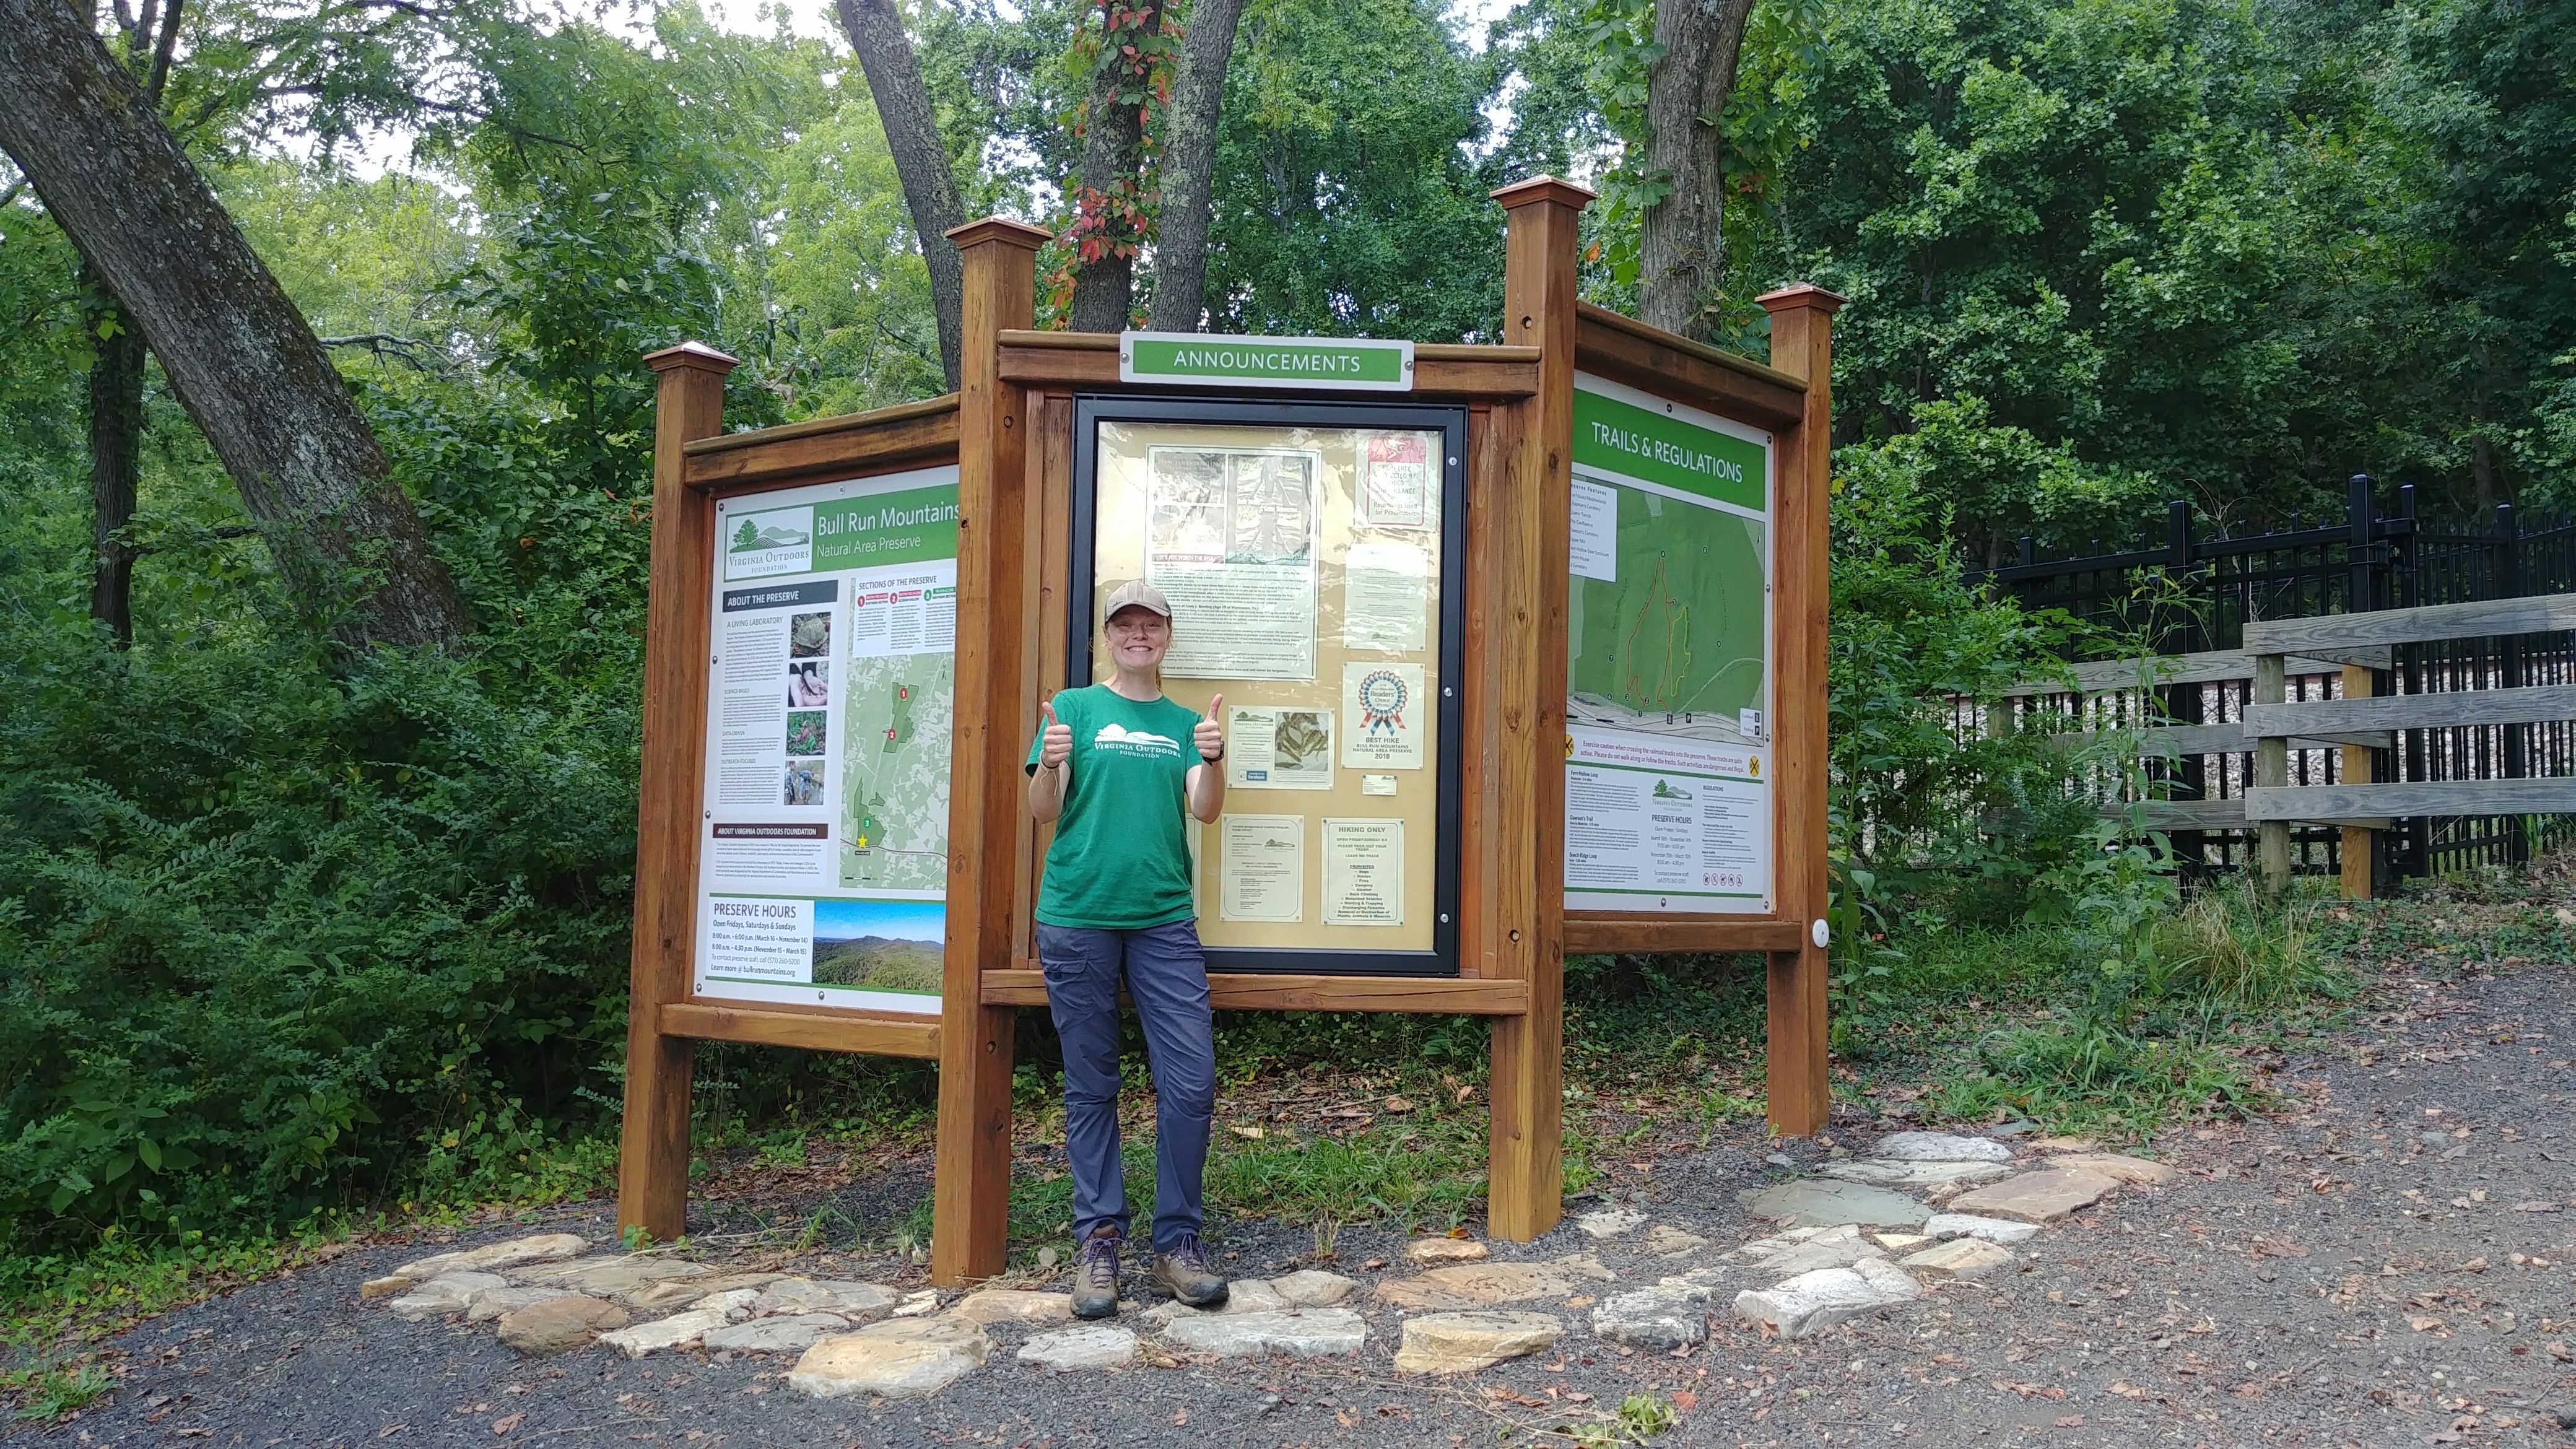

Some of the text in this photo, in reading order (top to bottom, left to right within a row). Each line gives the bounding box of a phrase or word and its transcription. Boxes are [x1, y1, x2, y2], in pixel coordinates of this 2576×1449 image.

[1173, 349, 1361, 372] ANNOUNCEMENTS
[1591, 421, 1742, 483] TRAILS & REGULATIONS
[1588, 487, 1607, 495] Features
[818, 501, 959, 536] Bull Run Mountains
[817, 535, 921, 558] Natural Area Preserve
[729, 550, 809, 567] VIRGINIA OUTDOORS
[752, 564, 788, 573] FOUNDATION
[859, 581, 886, 590] SECTIONS
[897, 578, 907, 586] THE
[909, 576, 937, 585] PRESERVE
[728, 590, 799, 607] ABOUT THE PRESERVE
[732, 619, 749, 627] LIVING
[750, 616, 783, 626] LABORATORY
[1095, 742, 1180, 758] VIRGINIA OUTDOORS
[1120, 751, 1160, 759] FOUNDATION
[1651, 814, 1674, 822] PRESERVE
[715, 903, 796, 918] PRESERVE HOURS
[713, 920, 726, 928] Open
[727, 920, 744, 928] Fridays,
[746, 921, 769, 930] Saturdays
[775, 923, 796, 931] Sundays
[744, 965, 795, 977] bullrunmountains.org
